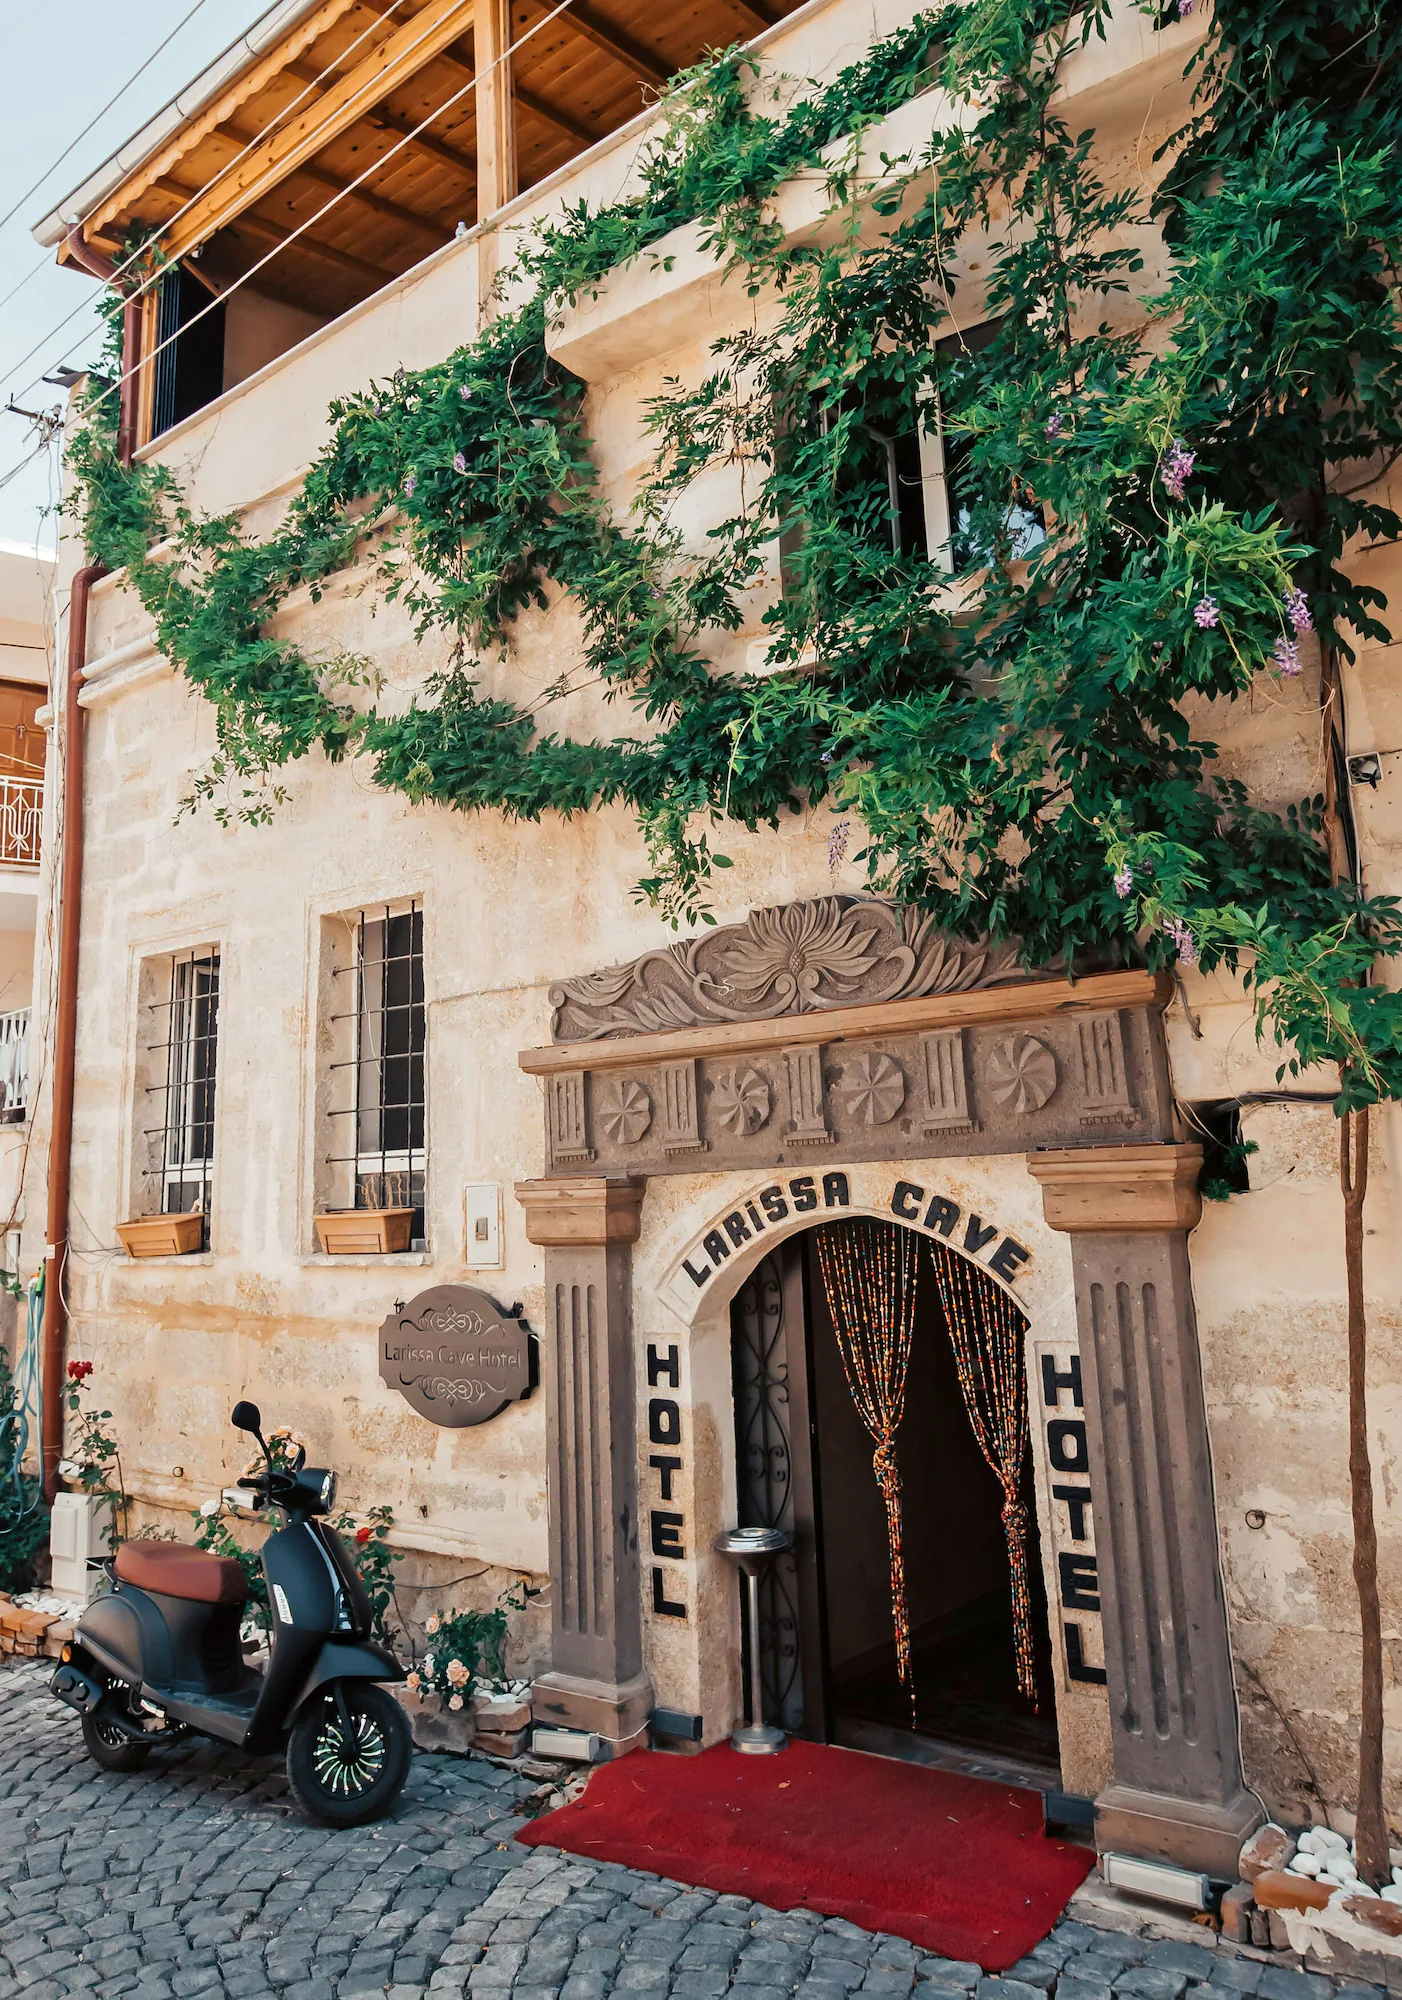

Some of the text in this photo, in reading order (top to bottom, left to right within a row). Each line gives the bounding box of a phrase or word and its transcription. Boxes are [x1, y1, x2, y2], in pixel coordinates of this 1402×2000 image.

[891, 1180, 1031, 1284] CAVE
[385, 1342, 521, 1369] Larissa Cave Hotel
[646, 1344, 686, 1618] HOTEL
[1041, 1354, 1107, 1685] HOTEL
